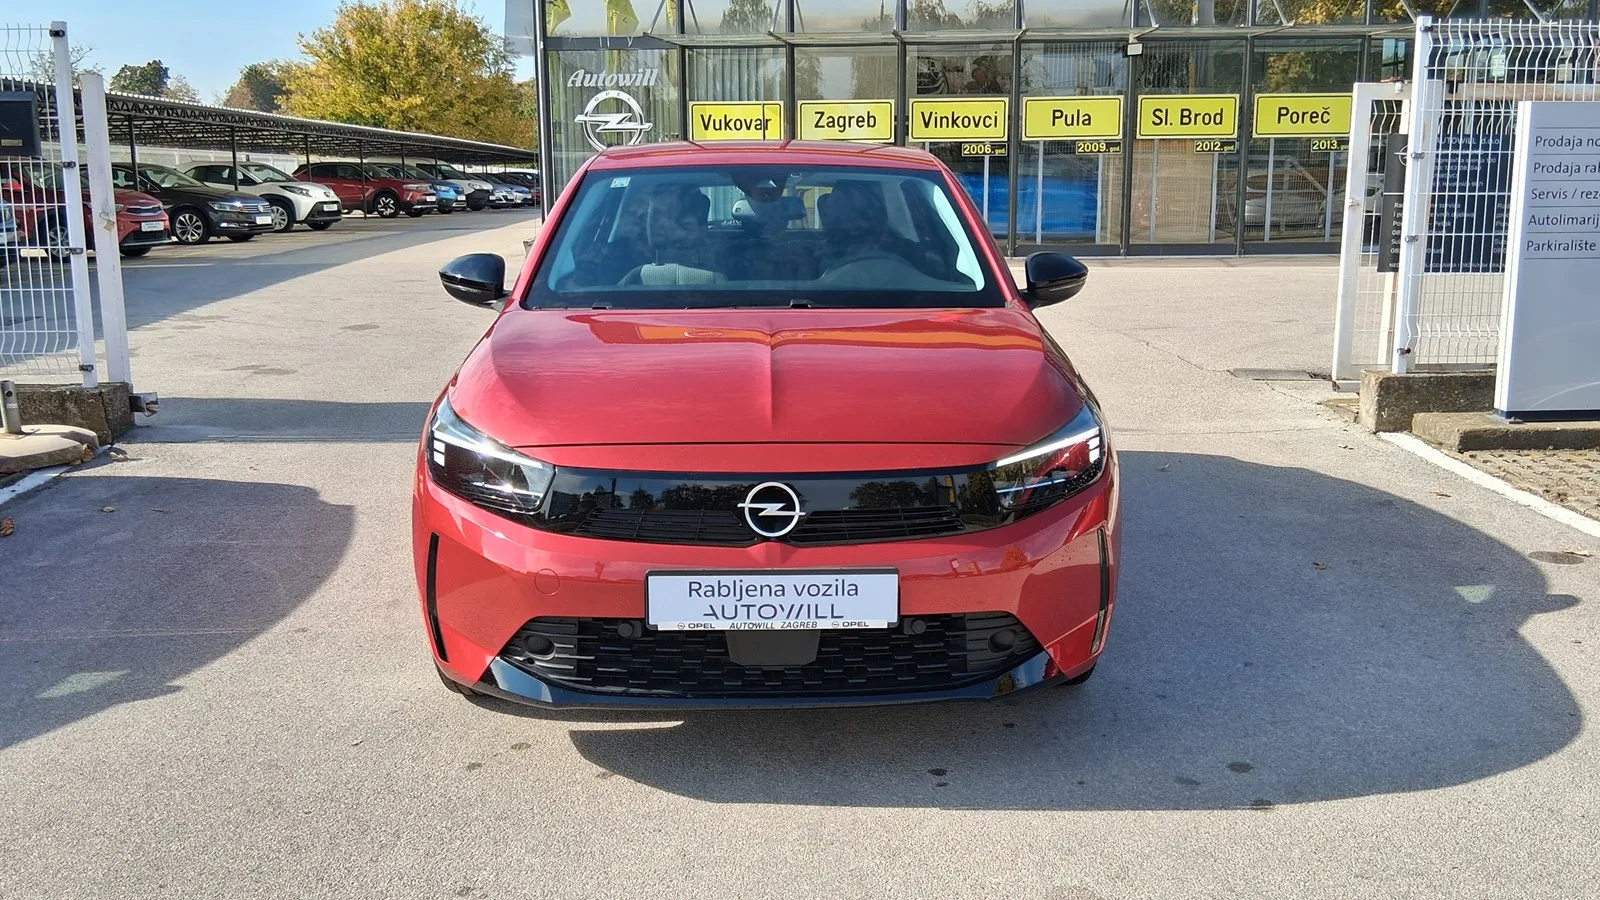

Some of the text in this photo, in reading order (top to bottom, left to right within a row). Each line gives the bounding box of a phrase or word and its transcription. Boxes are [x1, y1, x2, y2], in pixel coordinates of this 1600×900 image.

[567, 68, 658, 87] Autowill
[700, 113, 772, 132] Vukovar
[814, 111, 877, 133] Zagreb
[920, 111, 998, 129] Vinkovci
[1052, 109, 1092, 127] Pula
[1151, 108, 1224, 126] Sl. Brod
[1277, 106, 1331, 125] Poreč
[963, 144, 994, 154] 2006.
[1077, 142, 1109, 153] 2009.
[1196, 141, 1223, 151] 2012.
[1312, 140, 1340, 150] 2013.
[1535, 135, 1583, 150] Prodaja
[1533, 162, 1581, 177] Prodaja
[1531, 188, 1568, 200] Servis
[1571, 188, 1577, 200] /
[1526, 240, 1596, 252] Parkiralište
[688, 578, 859, 602] Rabljena vozila
[703, 604, 844, 620] AUTOWILL
[729, 622, 775, 630] AUTOWILL
